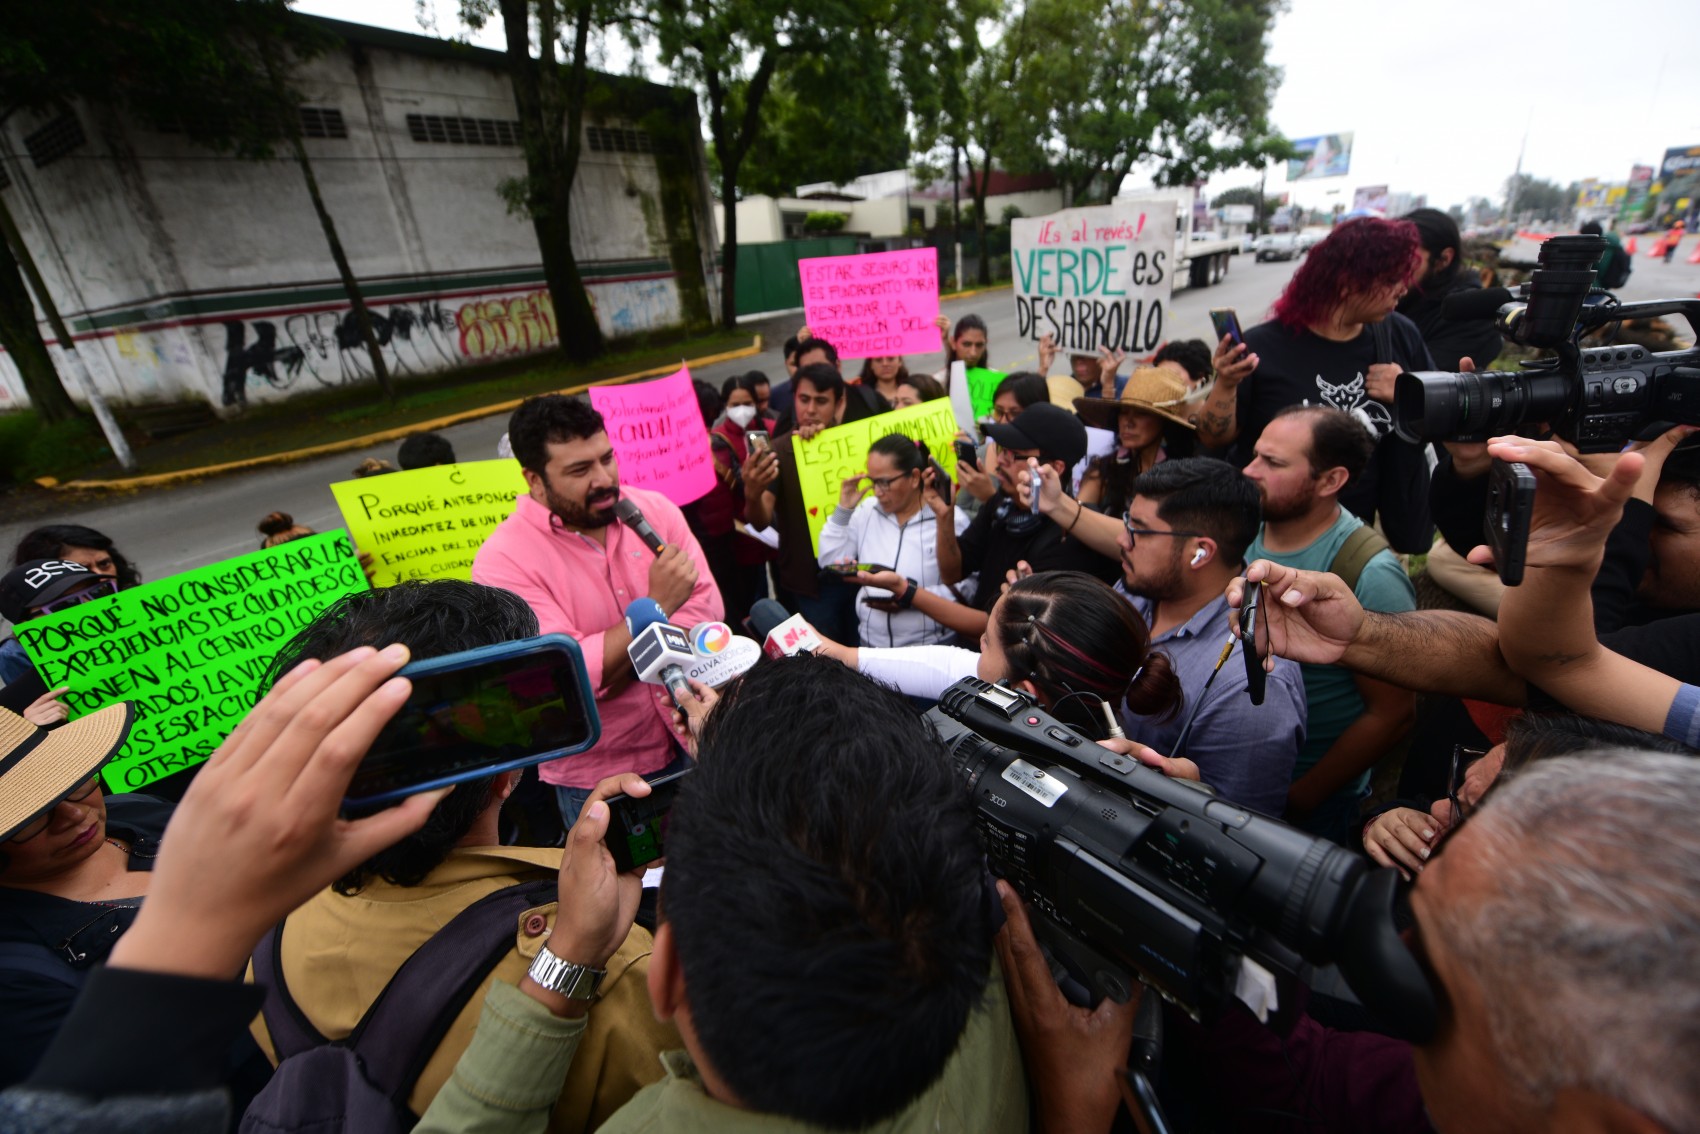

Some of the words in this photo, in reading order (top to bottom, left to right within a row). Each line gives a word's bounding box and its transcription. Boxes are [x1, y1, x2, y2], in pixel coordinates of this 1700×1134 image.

[1072, 218, 1088, 242] al
[1095, 212, 1147, 242] revés!
[806, 263, 854, 283] ESTAR
[917, 258, 935, 275] NO
[1013, 245, 1127, 297] VERDE
[1132, 250, 1166, 286] es
[809, 286, 824, 300] ES
[887, 299, 907, 315] LA
[901, 317, 928, 332] DEL
[1016, 295, 1163, 353] DESARROLLO
[800, 434, 857, 466] ESTE
[373, 519, 456, 545] INMEDIATEZ
[461, 518, 477, 528] DE
[479, 514, 497, 526] UN
[381, 546, 438, 566] ENCIMA
[443, 541, 465, 552] DEL
[409, 566, 429, 578] EL
[18, 597, 136, 658] PORQUÉ
[140, 594, 180, 622] NO
[179, 546, 323, 606] CONSIDERAR
[320, 536, 354, 564] LAS
[39, 611, 210, 689] EXPERIENCIAS
[208, 602, 246, 627] DE
[244, 567, 338, 615] CIUDADES
[61, 664, 160, 715] PONEN
[166, 651, 206, 677] AL
[198, 617, 285, 660] CENTRO
[203, 670, 243, 695] LA
[124, 739, 215, 788] OTRAS
[990, 793, 1007, 808] 3CCD
